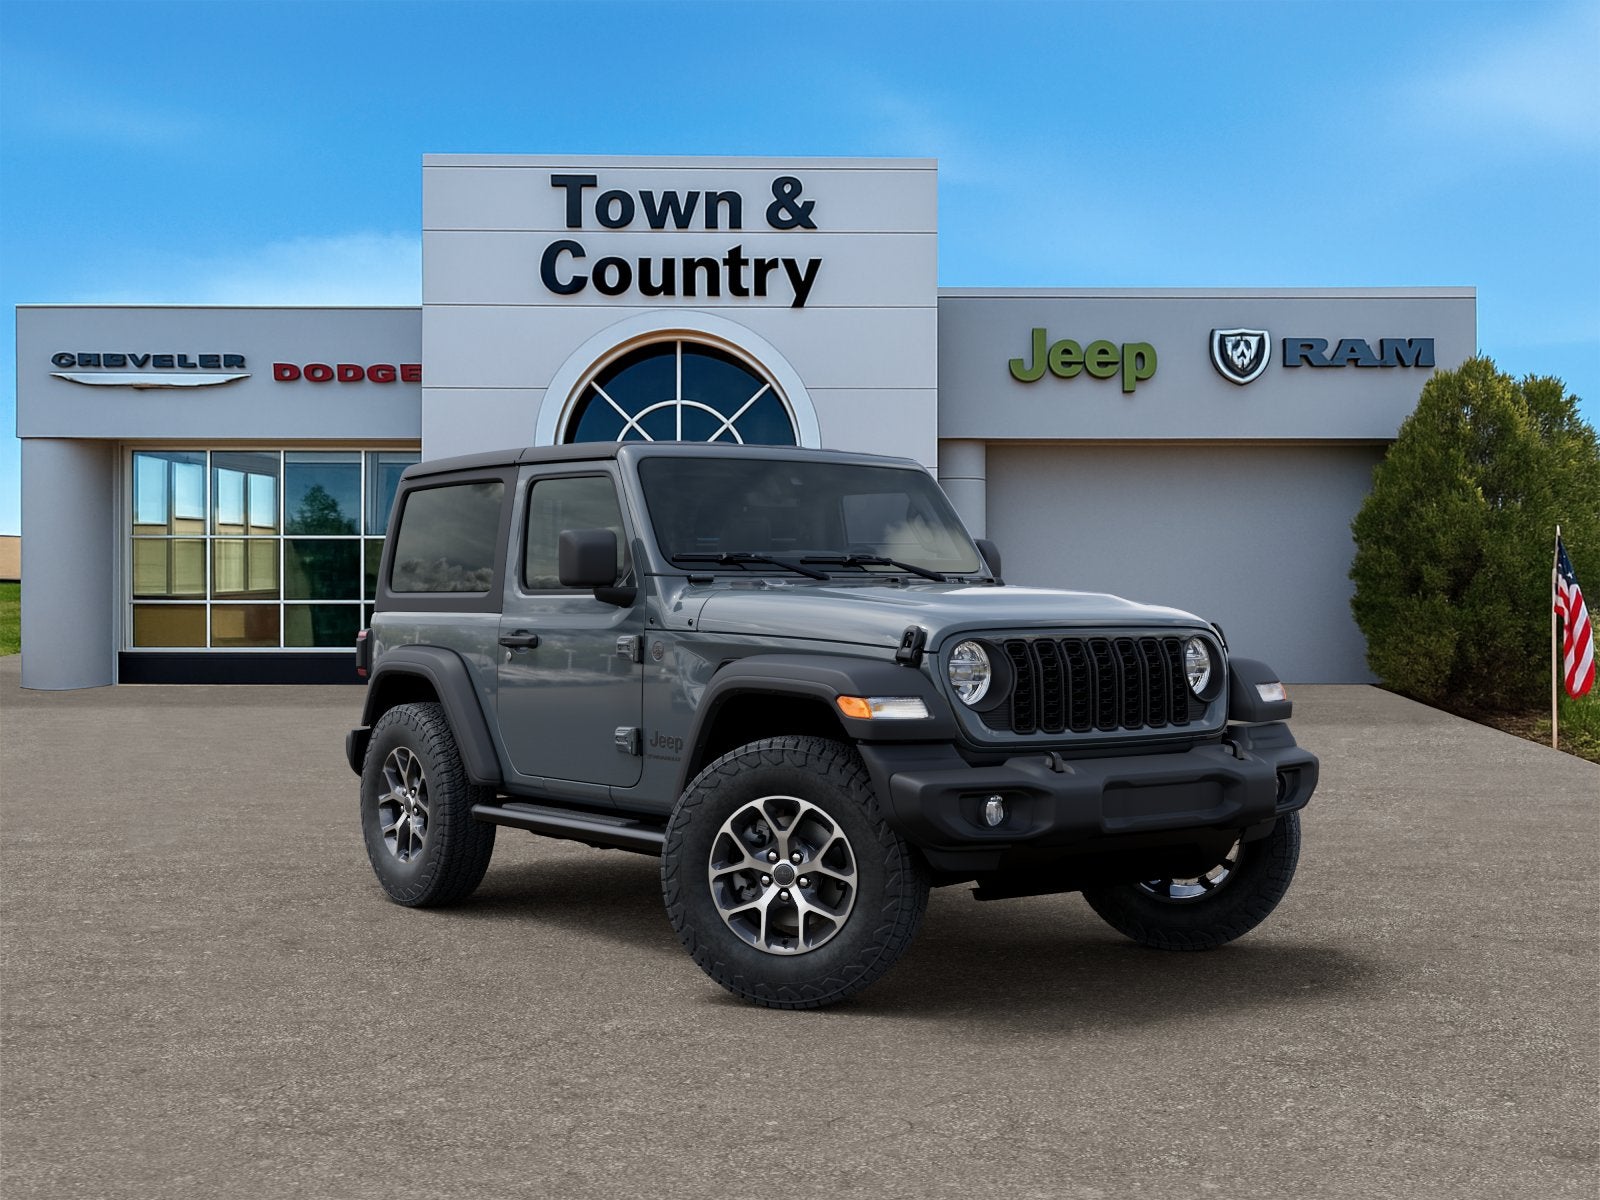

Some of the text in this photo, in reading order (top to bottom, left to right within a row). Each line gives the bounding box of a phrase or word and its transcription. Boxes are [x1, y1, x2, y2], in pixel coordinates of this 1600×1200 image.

[550, 174, 818, 230] Town &
[539, 239, 822, 308] Country
[272, 362, 422, 384] DODGE
[1009, 328, 1158, 393] Jeep
[1283, 337, 1436, 368] RAM
[649, 730, 684, 754] Jeep
